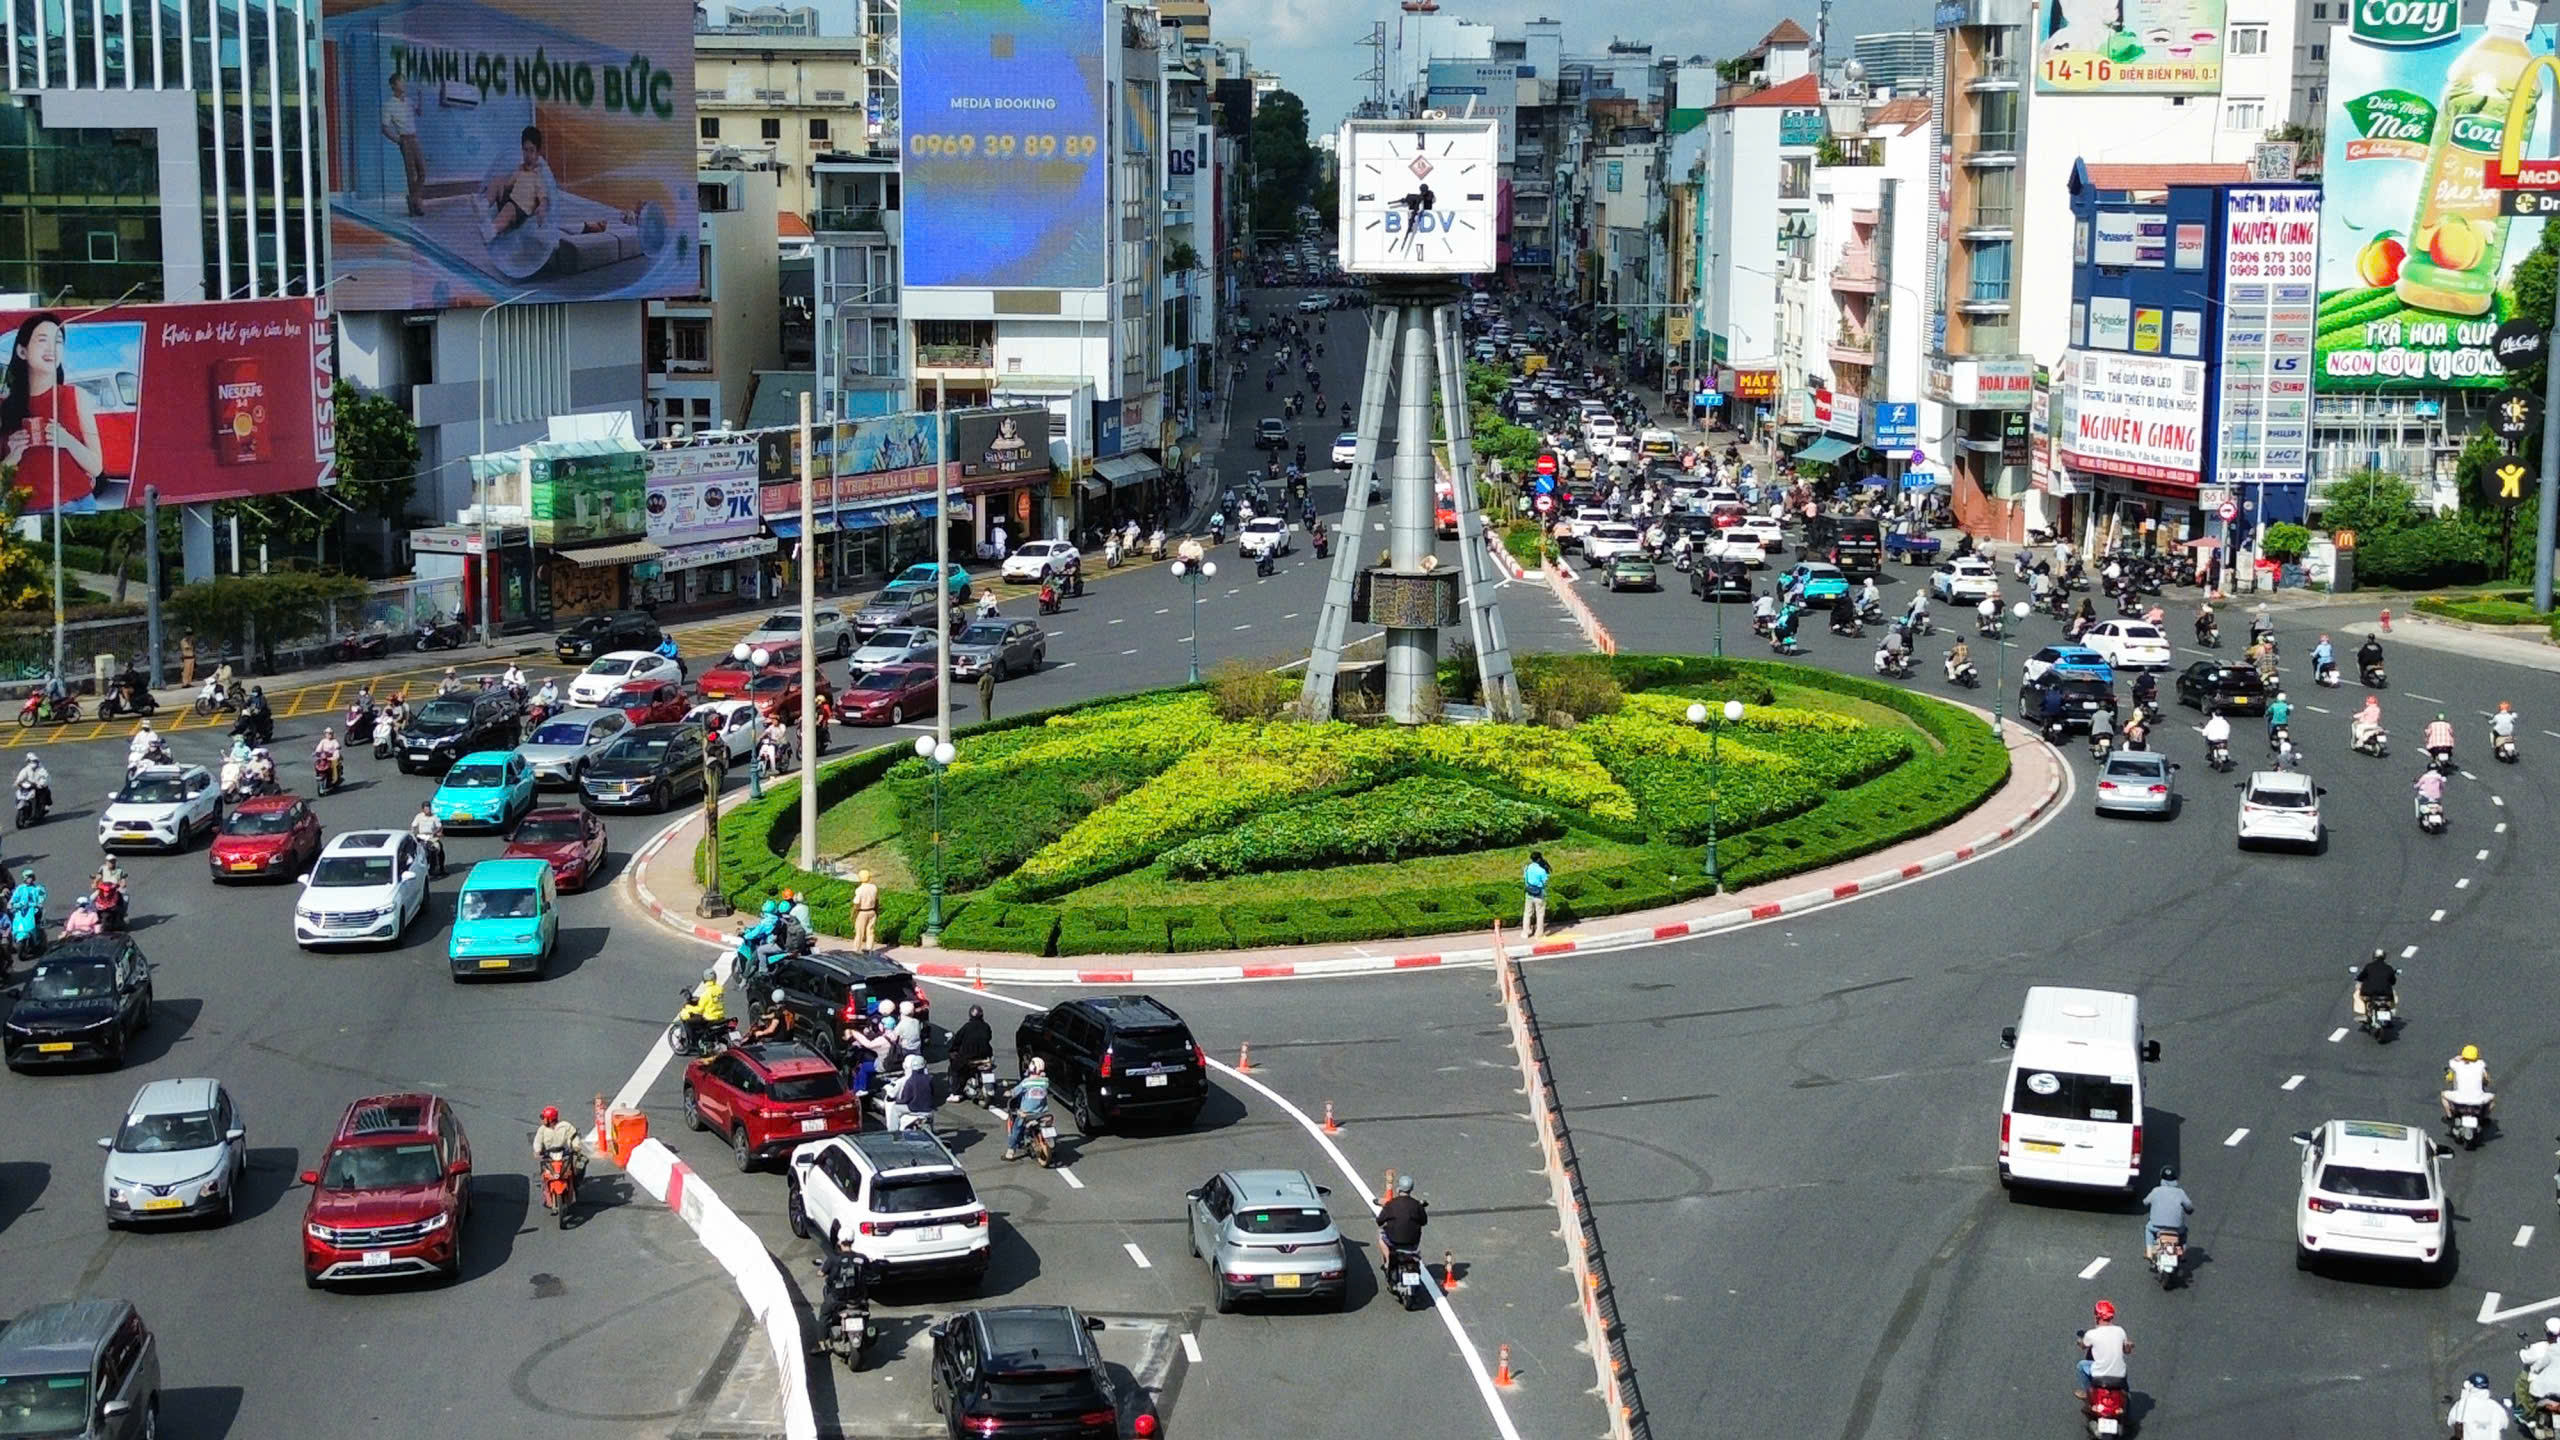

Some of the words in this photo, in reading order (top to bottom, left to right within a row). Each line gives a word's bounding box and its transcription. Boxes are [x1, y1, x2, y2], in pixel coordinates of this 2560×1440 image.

[2362, 0, 2448, 33] Cozy
[2045, 59, 2111, 81] 14-16
[391, 44, 460, 86] THANH
[465, 51, 508, 102] LỌC
[602, 51, 674, 119] BỨC
[951, 97, 992, 109] MEDIA
[995, 97, 1056, 110] BOOKING
[2366, 95, 2397, 111] Diện
[2366, 111, 2427, 139] Mới
[910, 134, 976, 155] 0969
[984, 134, 1016, 155] 39
[1025, 134, 1057, 155] 89
[1065, 134, 1097, 156] 89
[2518, 169, 2560, 184] McD
[1385, 211, 1456, 233] BDV
[2097, 230, 2134, 242] Panasonic
[2231, 216, 2278, 245] NGUYỄN
[2280, 222, 2314, 245] GIANG
[2290, 251, 2312, 262] 300
[2290, 265, 2311, 276] 300
[2229, 333, 2264, 342] MPE
[2365, 318, 2402, 346] TRÀ
[2409, 322, 2448, 346] HOA
[2274, 358, 2298, 371] LS
[2330, 354, 2371, 370] NGON
[2008, 375, 2030, 391] ANH
[2080, 409, 2143, 446] NGUYỄN
[2148, 422, 2196, 453] GIANG
[2267, 430, 2302, 438] PHILIPS
[2502, 423, 2525, 432] 24/7
[727, 495, 753, 519] 7K
